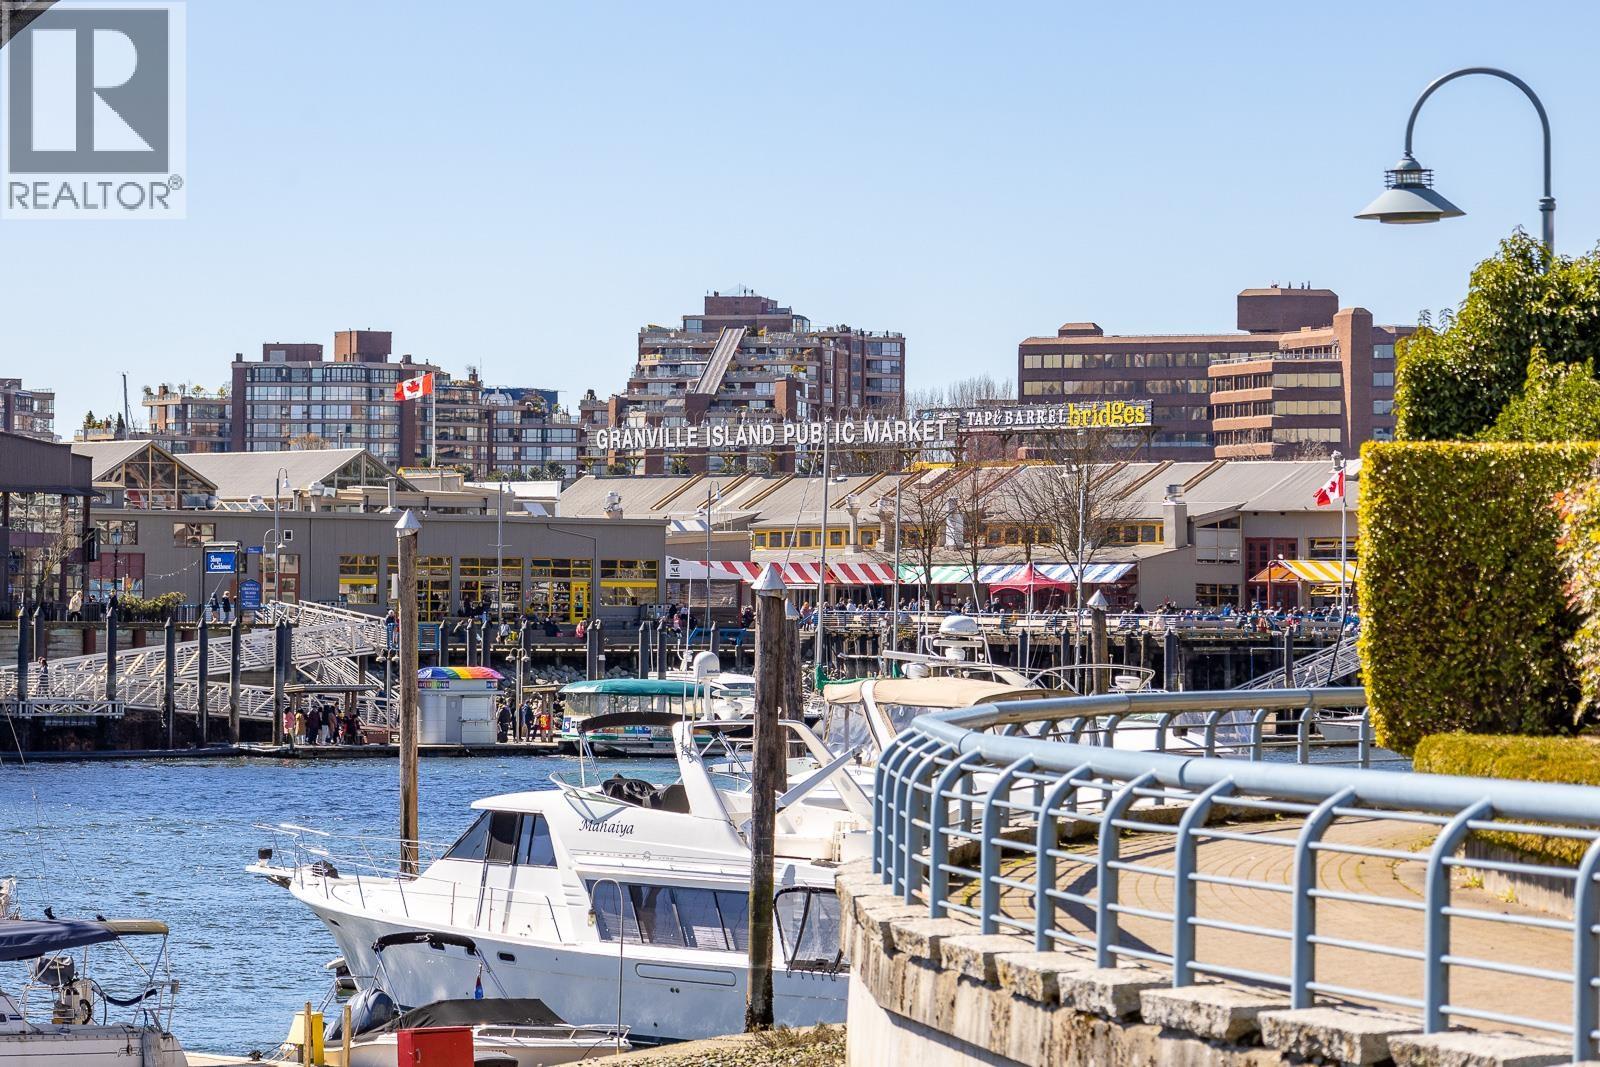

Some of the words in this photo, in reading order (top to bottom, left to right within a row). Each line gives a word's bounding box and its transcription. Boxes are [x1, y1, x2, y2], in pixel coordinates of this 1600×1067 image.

[1004, 408, 1066, 425] BARREL
[1068, 402, 1145, 427] bridges
[596, 426, 698, 450] GRANVILLE
[706, 424, 775, 447] ISLAND
[864, 419, 948, 443] MARKET
[579, 819, 634, 837] Mahaiya
